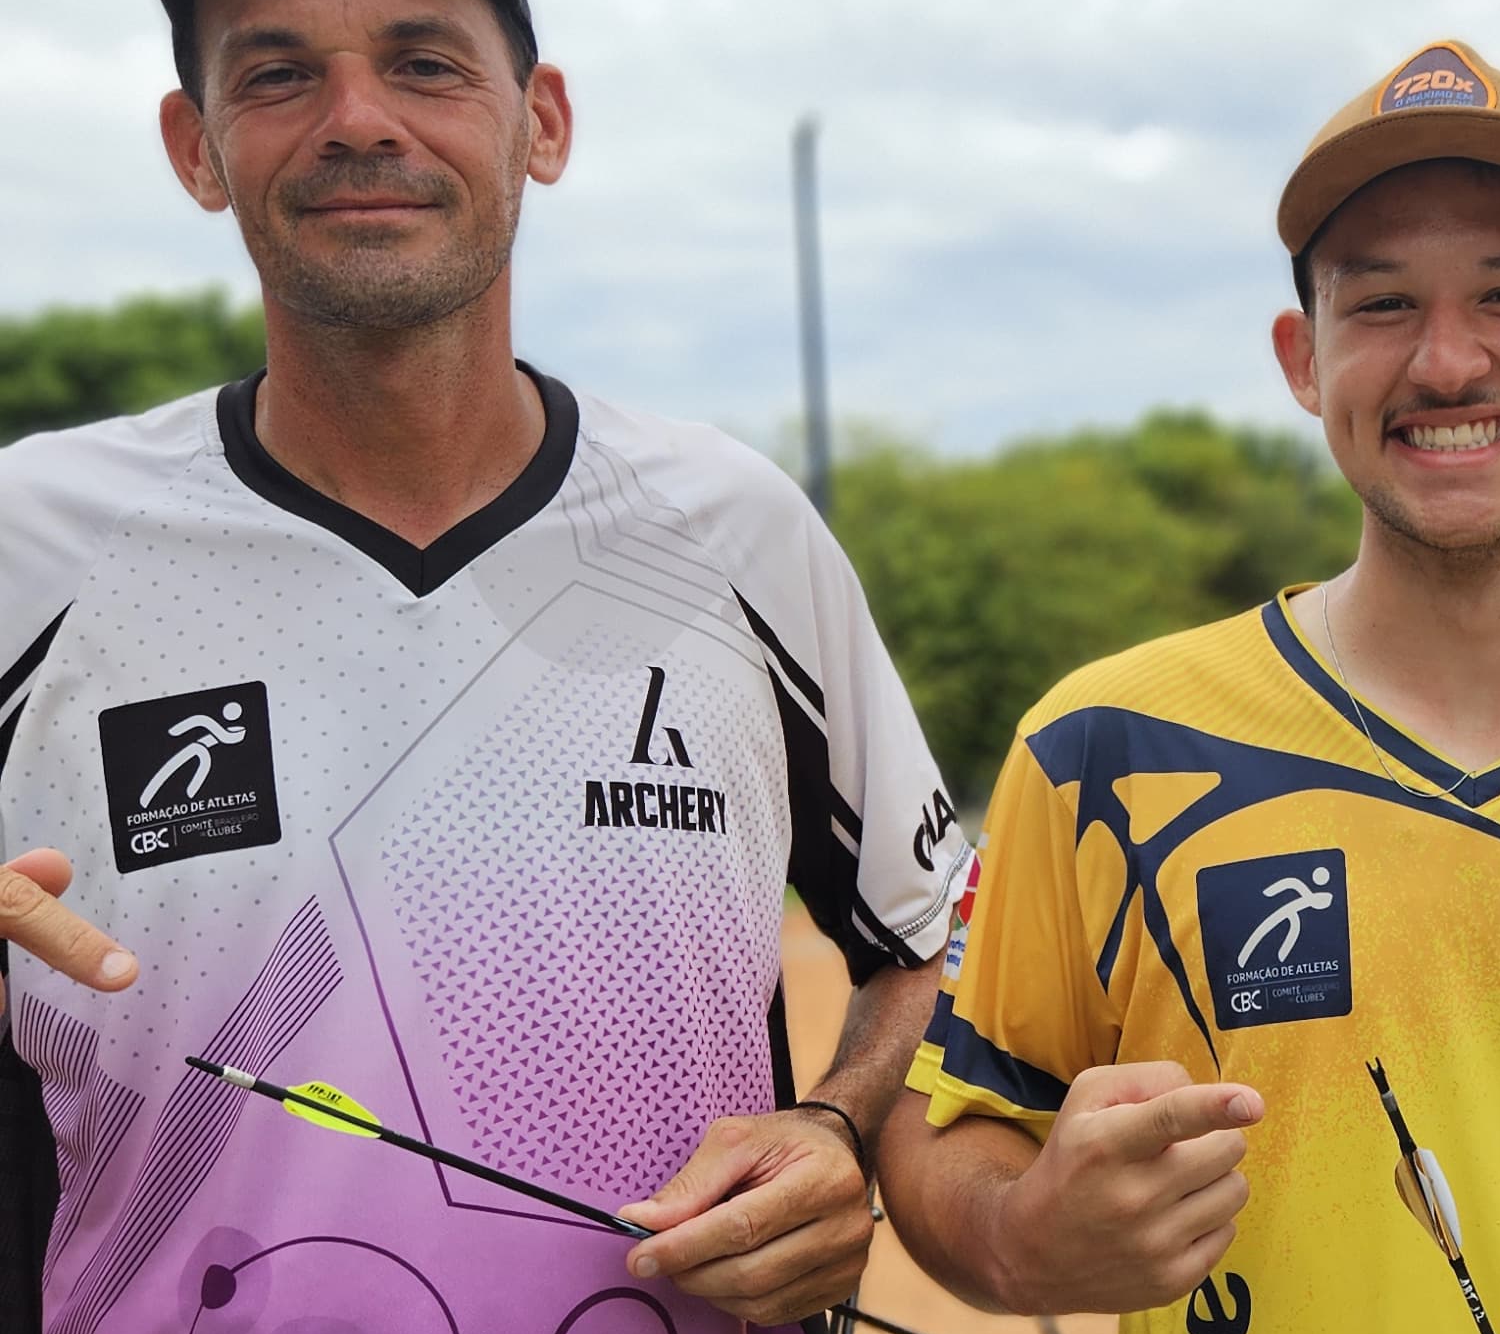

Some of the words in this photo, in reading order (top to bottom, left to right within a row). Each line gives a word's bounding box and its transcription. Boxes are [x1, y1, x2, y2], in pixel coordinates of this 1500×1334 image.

[1393, 70, 1474, 100] 720x
[127, 804, 189, 827] FORMAÇÃO
[190, 800, 207, 813] DE
[207, 791, 257, 809] ATLETAS
[584, 780, 727, 835] ARCHERY
[180, 818, 213, 835] COMITÊ
[207, 823, 243, 838] CLUBES
[130, 827, 170, 854] CBC
[1226, 967, 1279, 985] FORMAÇÃO
[1281, 965, 1294, 977] DE
[1296, 960, 1339, 975] ATLETAS
[1230, 989, 1262, 1013] CBC
[1295, 992, 1326, 1004] CLUBES
